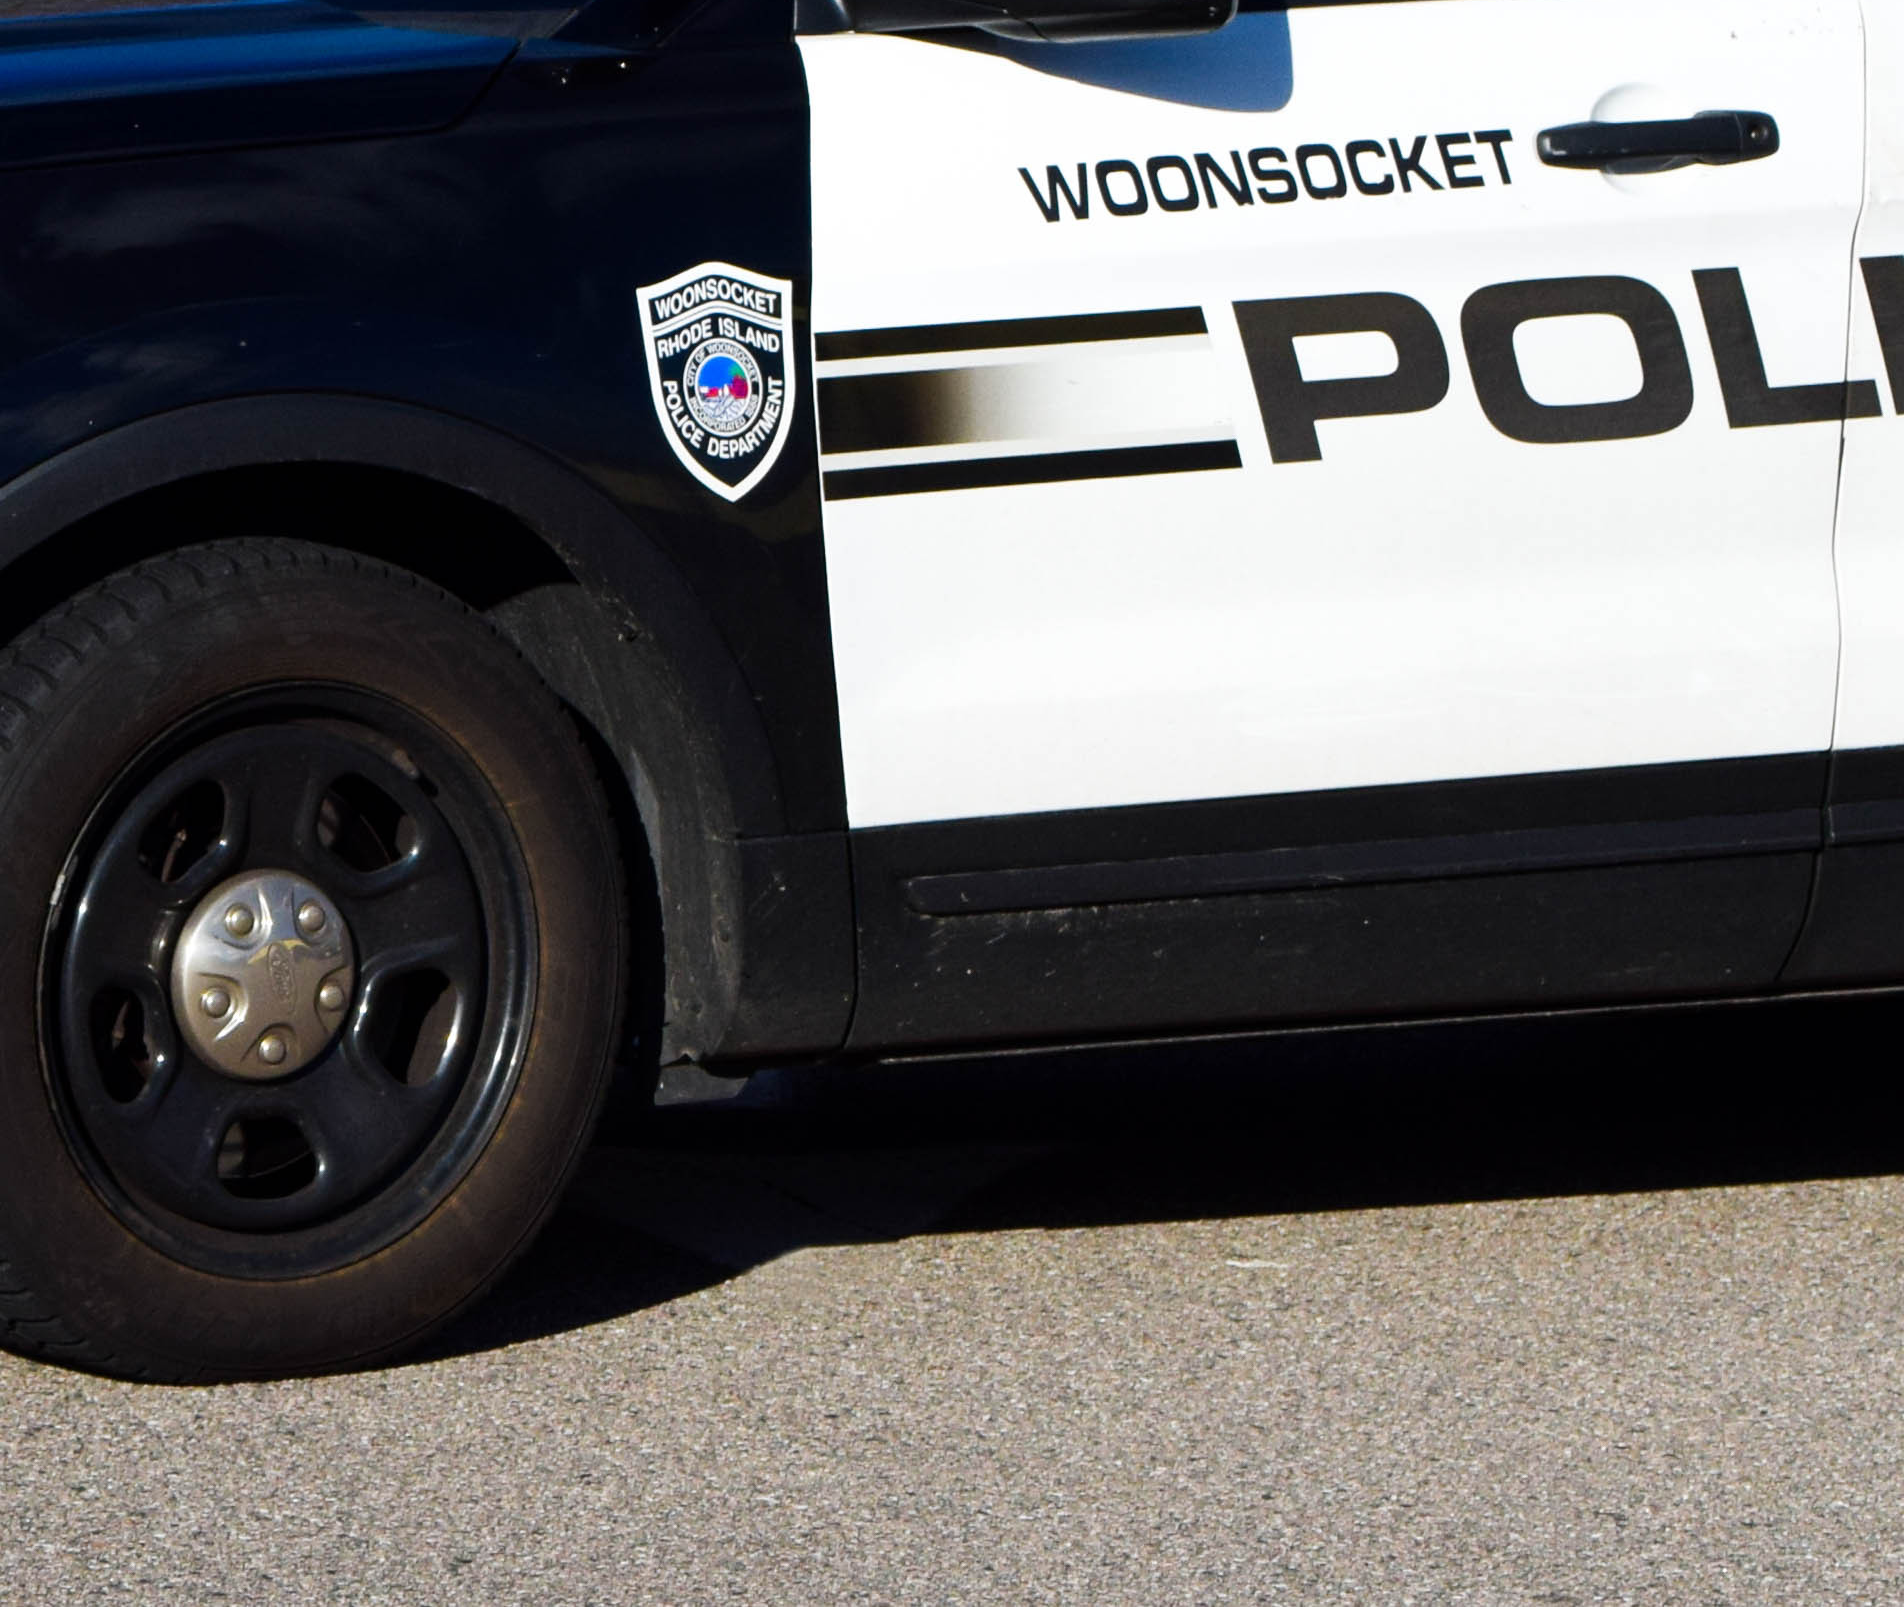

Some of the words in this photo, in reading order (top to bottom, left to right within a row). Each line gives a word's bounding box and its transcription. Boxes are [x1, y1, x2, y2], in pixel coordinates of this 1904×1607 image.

[1018, 129, 1513, 223] WOONSOCKET
[655, 278, 777, 319] WOONSOCKET
[657, 317, 713, 358] RHODE
[718, 317, 780, 353] ISLAND
[663, 380, 705, 448] POLICE
[707, 376, 783, 459] DEPARTMENT
